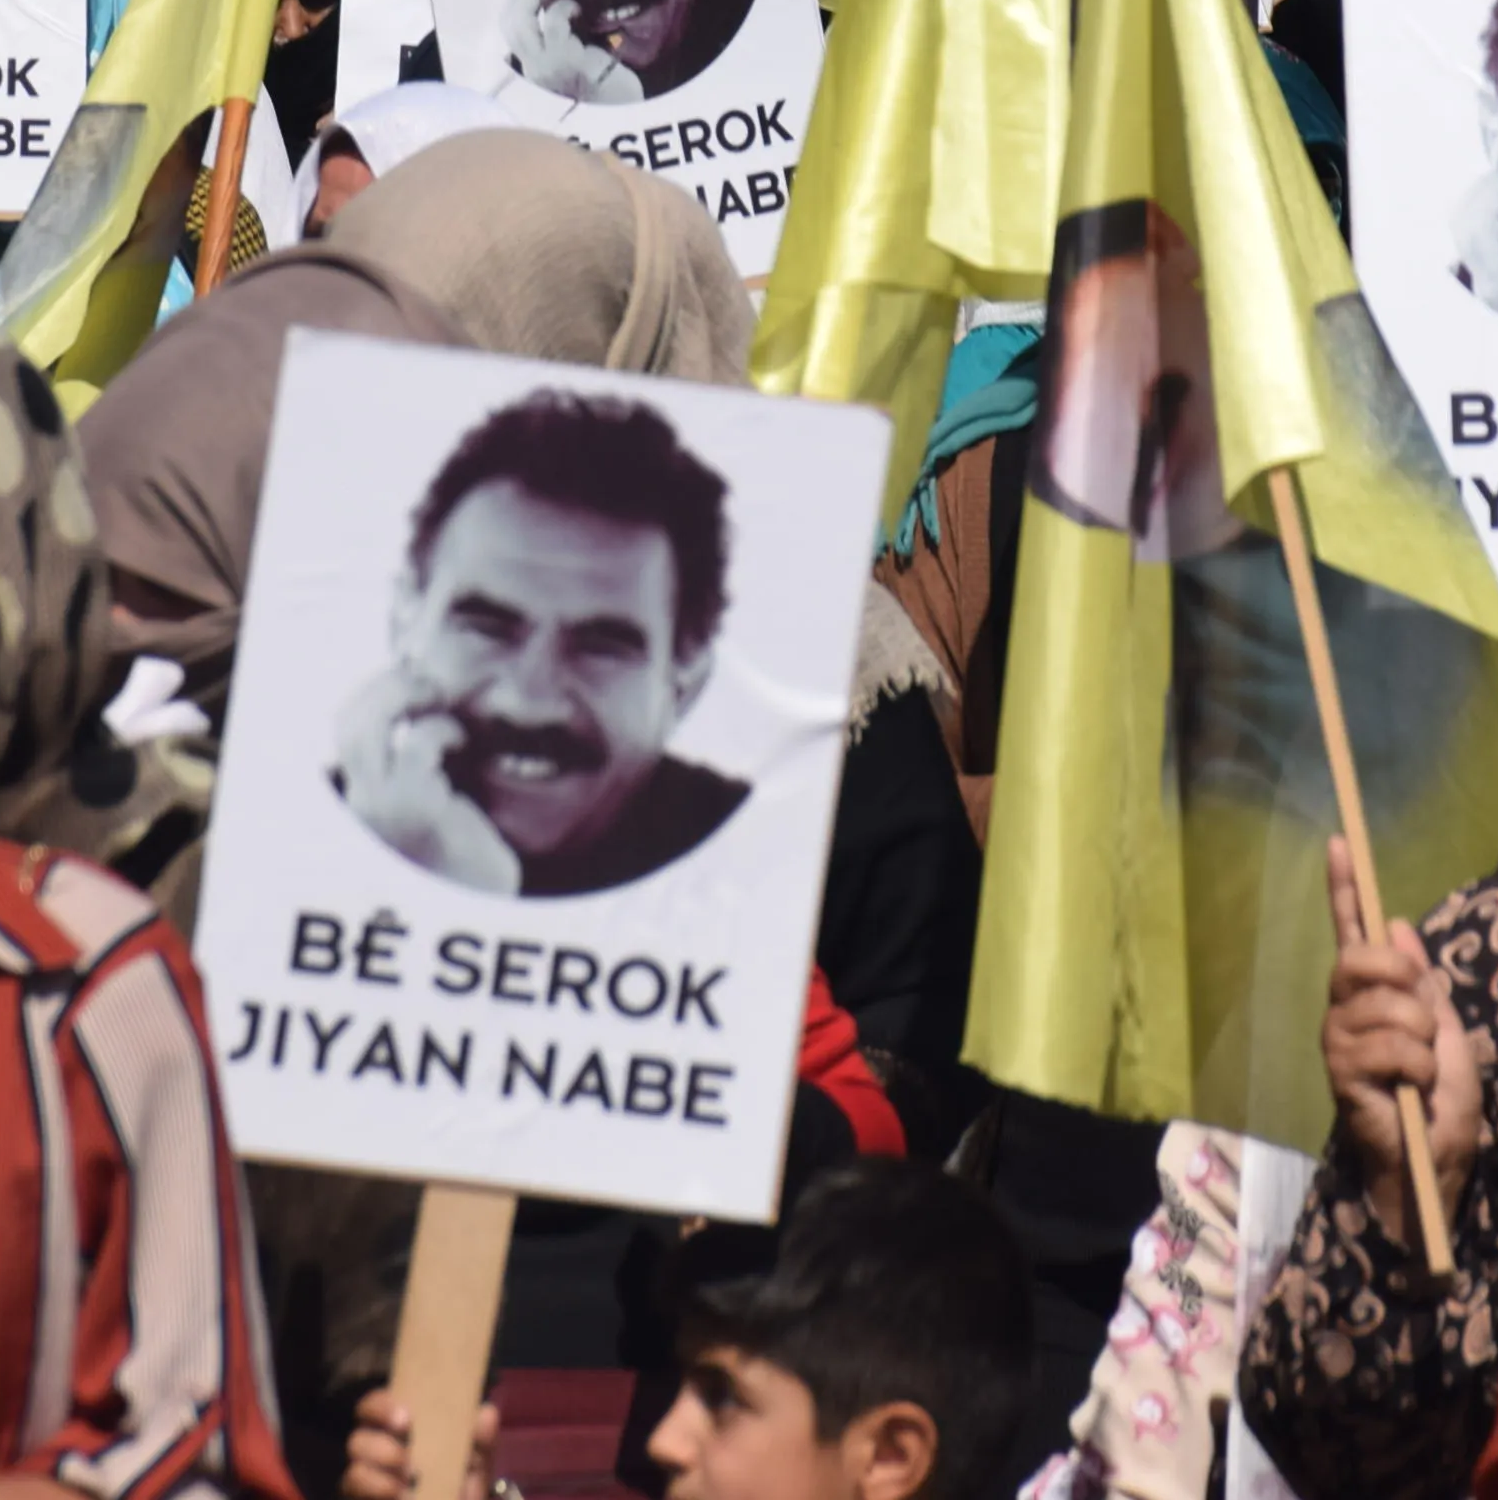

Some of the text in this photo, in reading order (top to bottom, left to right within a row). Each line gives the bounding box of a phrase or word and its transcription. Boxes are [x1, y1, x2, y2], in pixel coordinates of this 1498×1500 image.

[610, 99, 794, 171] SEROK
[288, 908, 729, 1029] BÊ SEROK
[227, 1002, 736, 1128] JIYAN NABE
